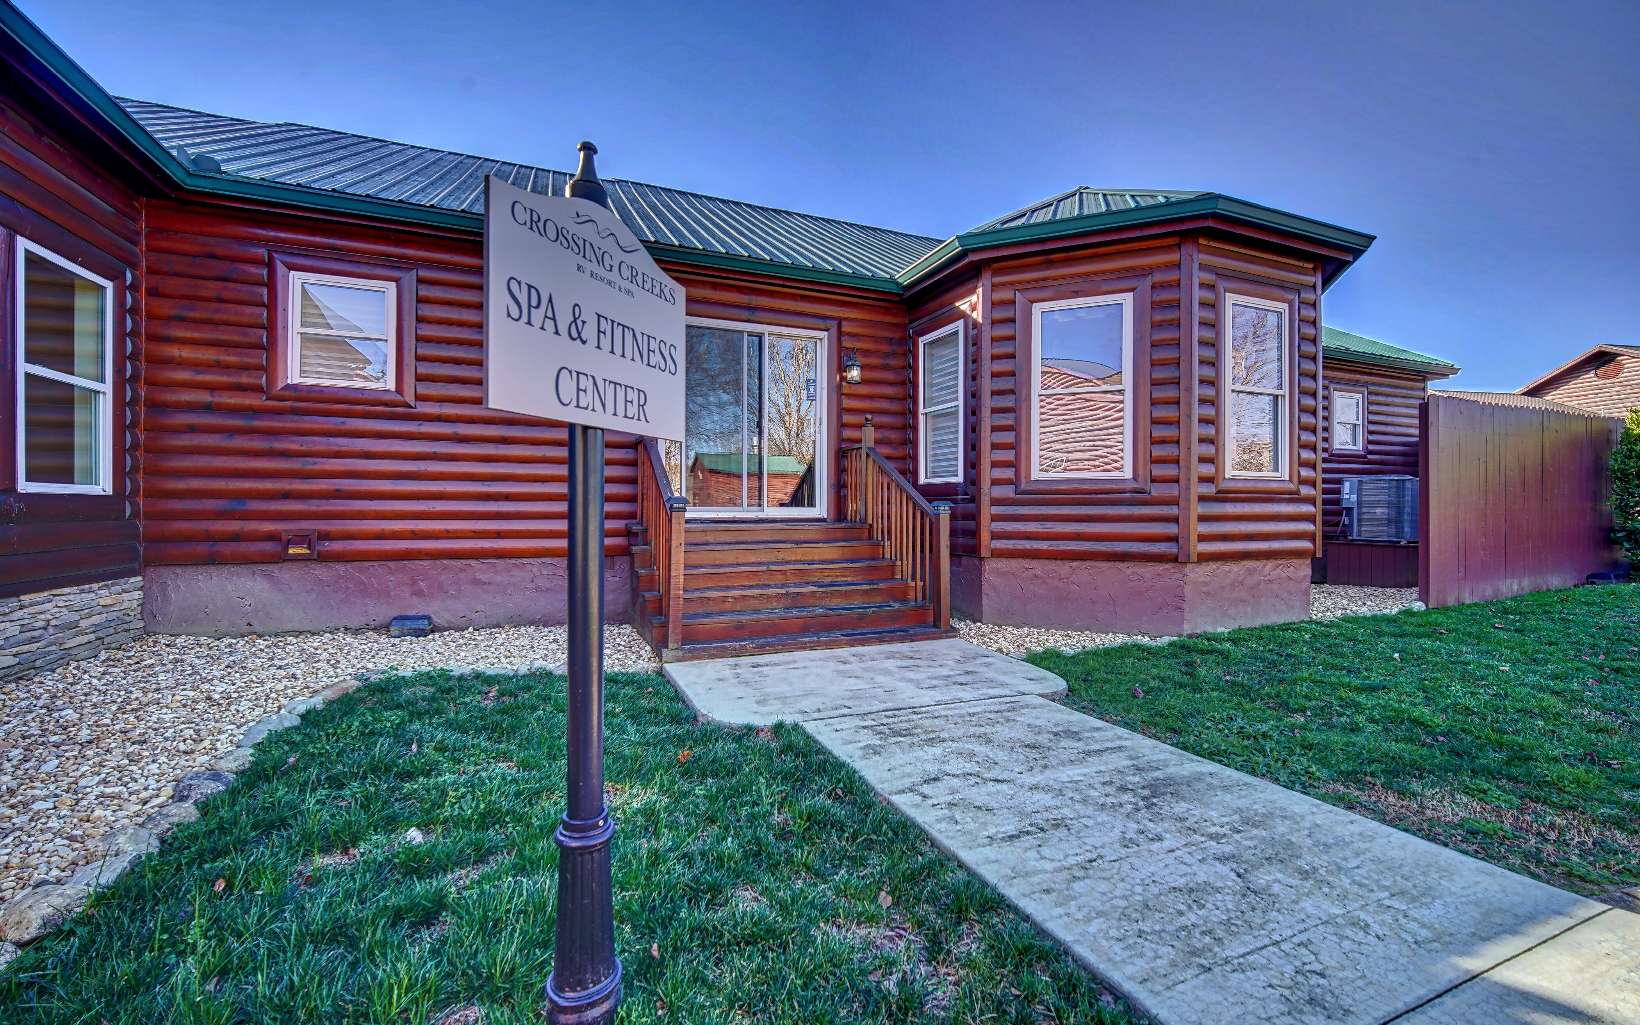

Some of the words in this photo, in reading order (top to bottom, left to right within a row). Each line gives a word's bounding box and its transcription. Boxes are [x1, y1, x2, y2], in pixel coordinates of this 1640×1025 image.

[511, 200, 614, 272] CROSSING
[618, 260, 677, 306] CREEKS
[576, 263, 585, 274] RV
[590, 271, 617, 290] RESORT
[624, 287, 635, 299] SPA
[506, 276, 562, 337] SPA
[568, 303, 588, 345] &
[595, 312, 678, 376] FITNESS
[555, 366, 650, 424] CENTER
